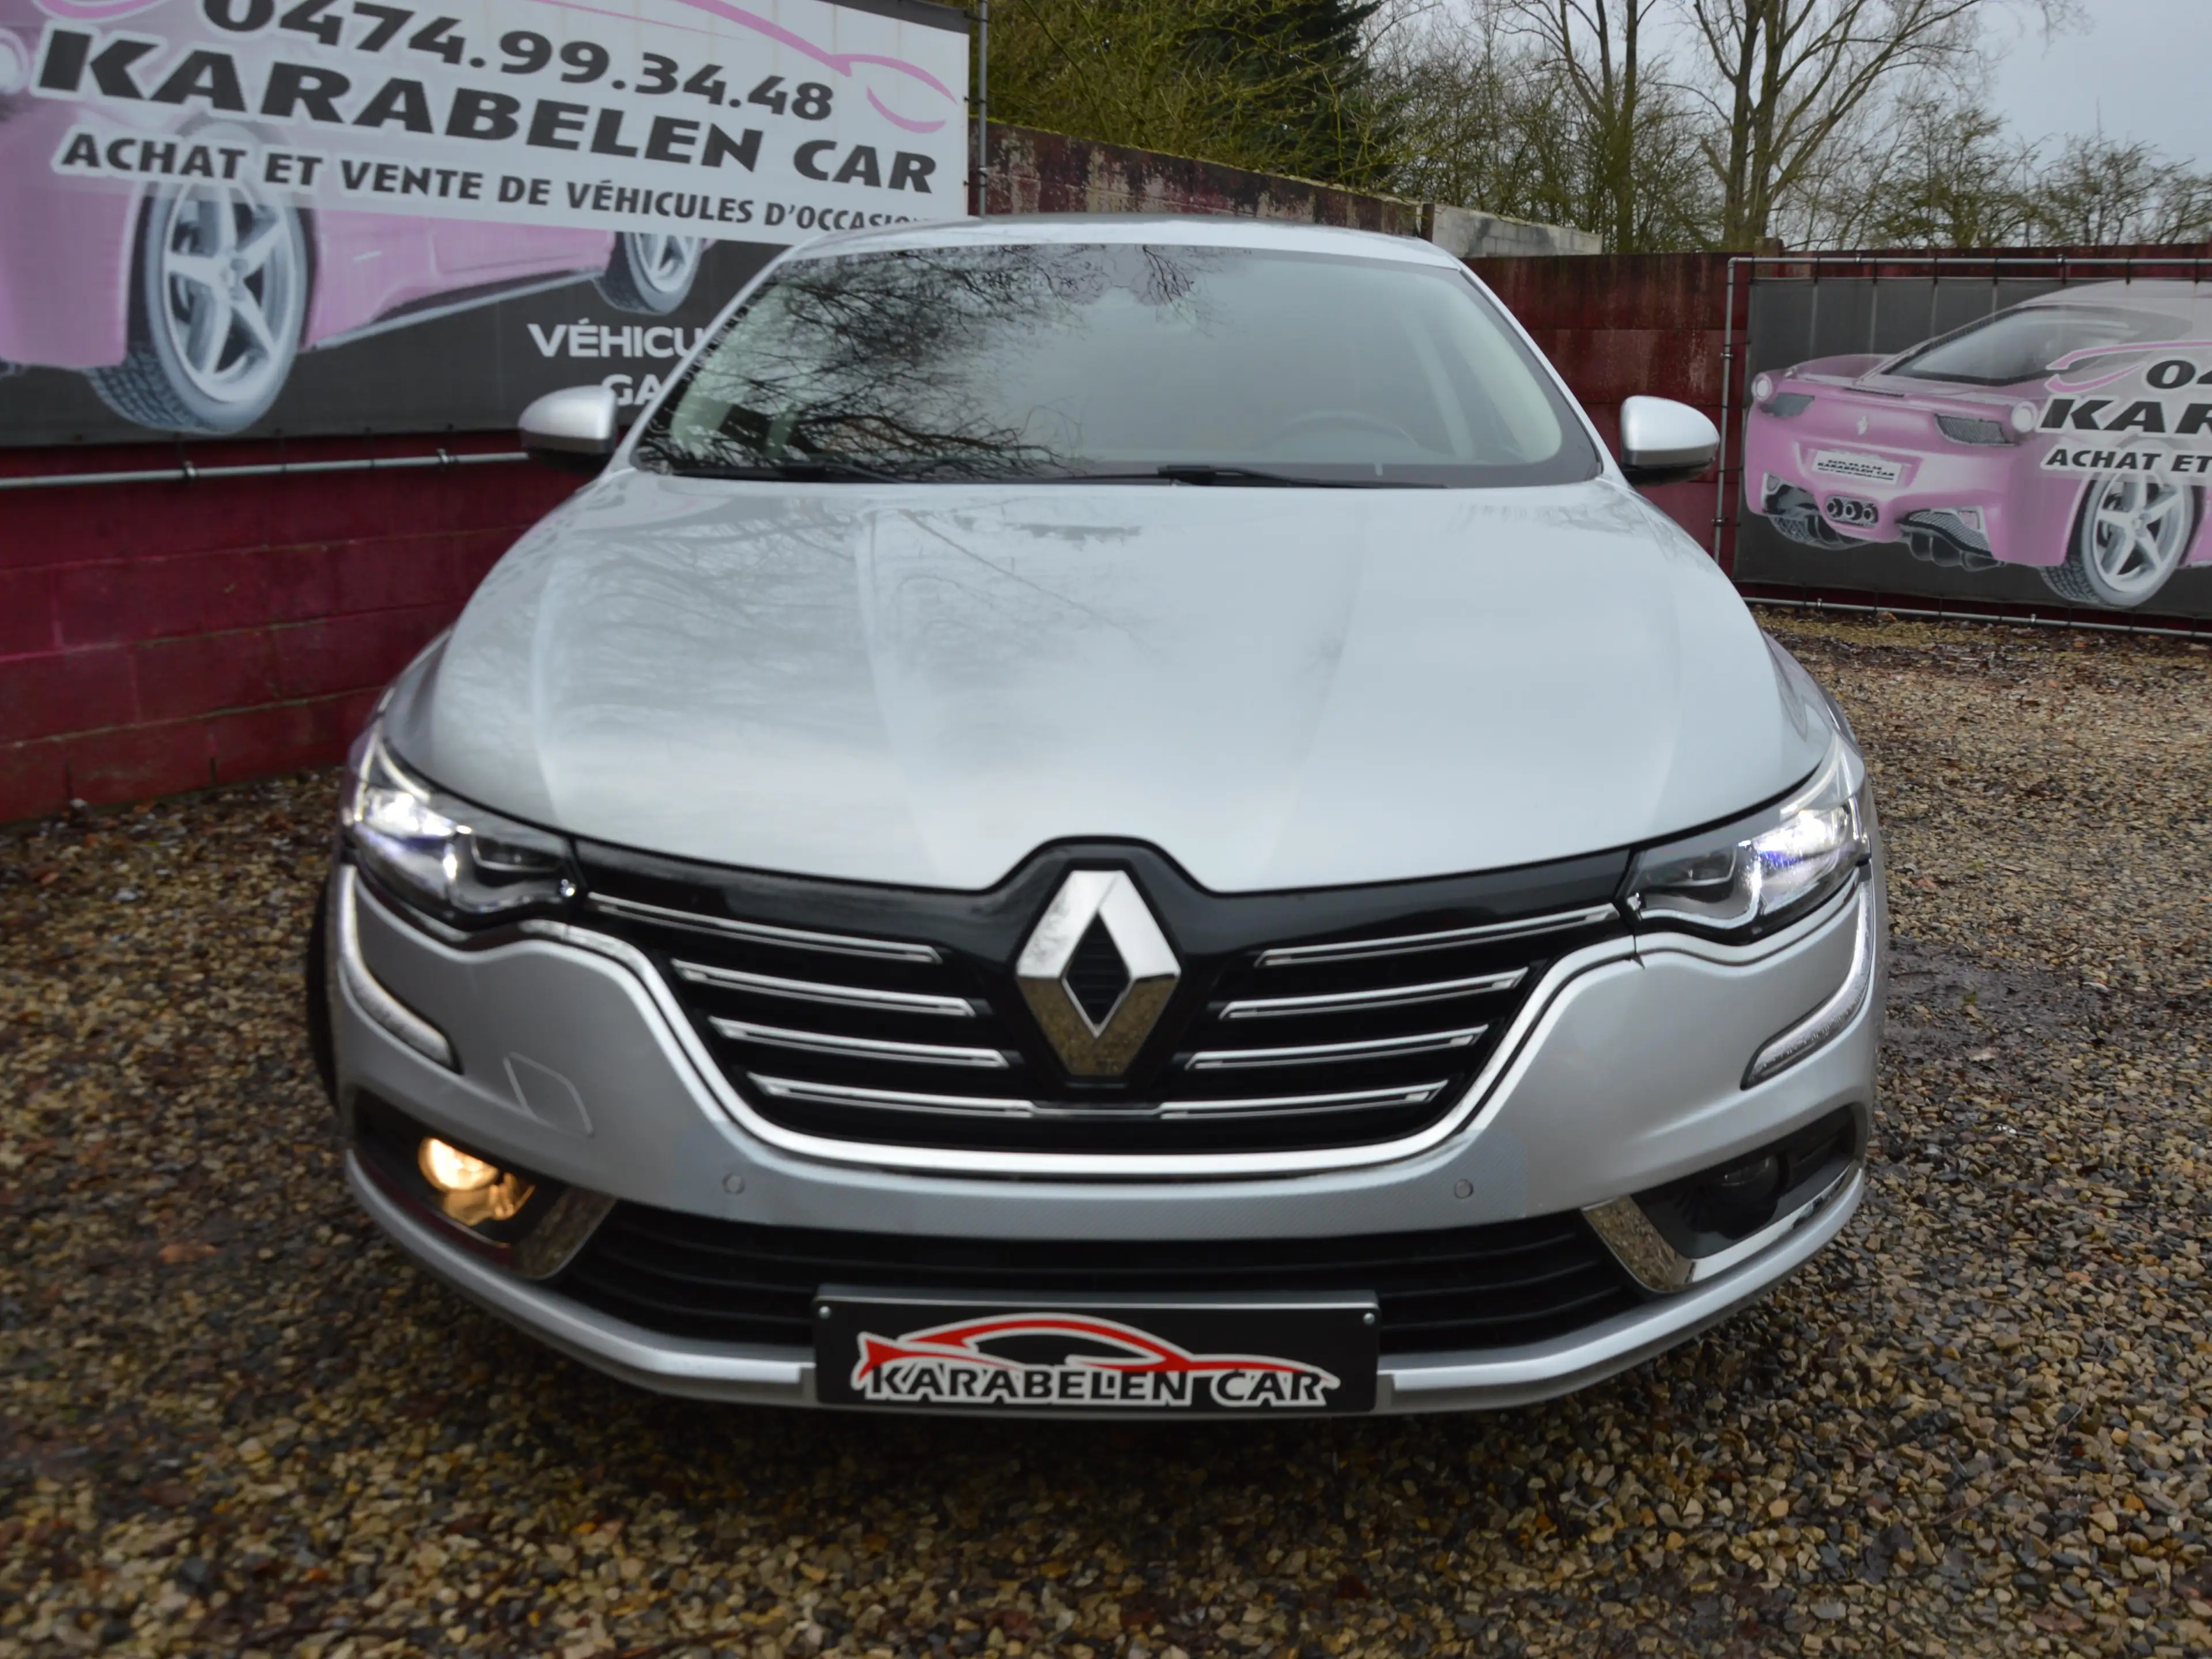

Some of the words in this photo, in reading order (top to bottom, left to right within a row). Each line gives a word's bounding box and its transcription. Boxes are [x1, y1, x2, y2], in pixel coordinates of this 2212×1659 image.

[203, 0, 834, 121] 0474.99.34.48
[39, 29, 763, 173] KARABELEN
[793, 140, 937, 194] CAR
[61, 132, 246, 180] ACHAT
[264, 153, 323, 186] ET
[341, 160, 483, 200] VENTE
[498, 175, 551, 206] DE
[567, 181, 753, 224] VÉHICULES
[2045, 449, 2162, 471] ACHAT
[2171, 454, 2212, 473] ET
[871, 1366, 1189, 1401] KARABELEN
[1216, 1370, 1321, 1401] CAR
